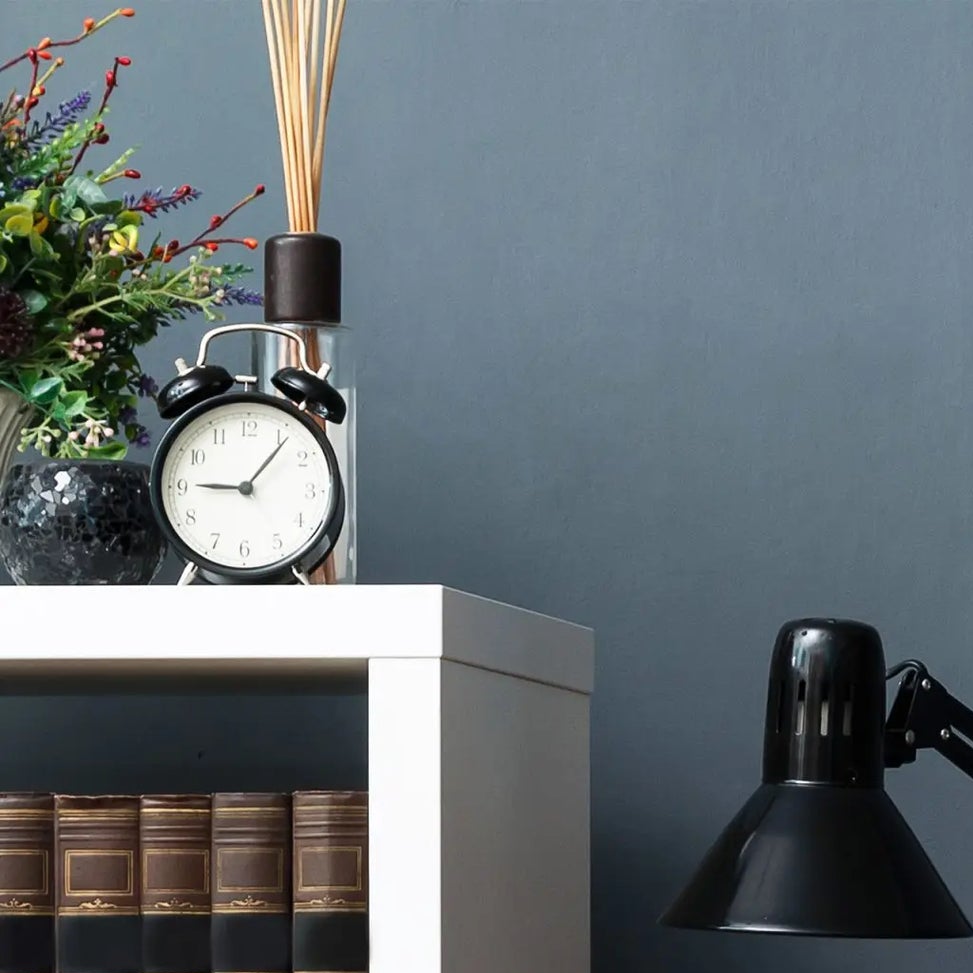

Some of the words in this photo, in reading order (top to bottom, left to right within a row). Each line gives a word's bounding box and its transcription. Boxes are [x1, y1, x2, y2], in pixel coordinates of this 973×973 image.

[213, 429, 226, 445] 11
[241, 420, 258, 437] 12
[276, 429, 283, 445] 1
[191, 449, 205, 465] 10
[297, 451, 308, 467] 2
[177, 479, 188, 496] 9
[305, 483, 316, 500] 3
[186, 509, 196, 526] 8
[293, 512, 304, 528] 4
[210, 533, 221, 550] 7
[239, 540, 250, 557] 6
[272, 533, 283, 550] 5
